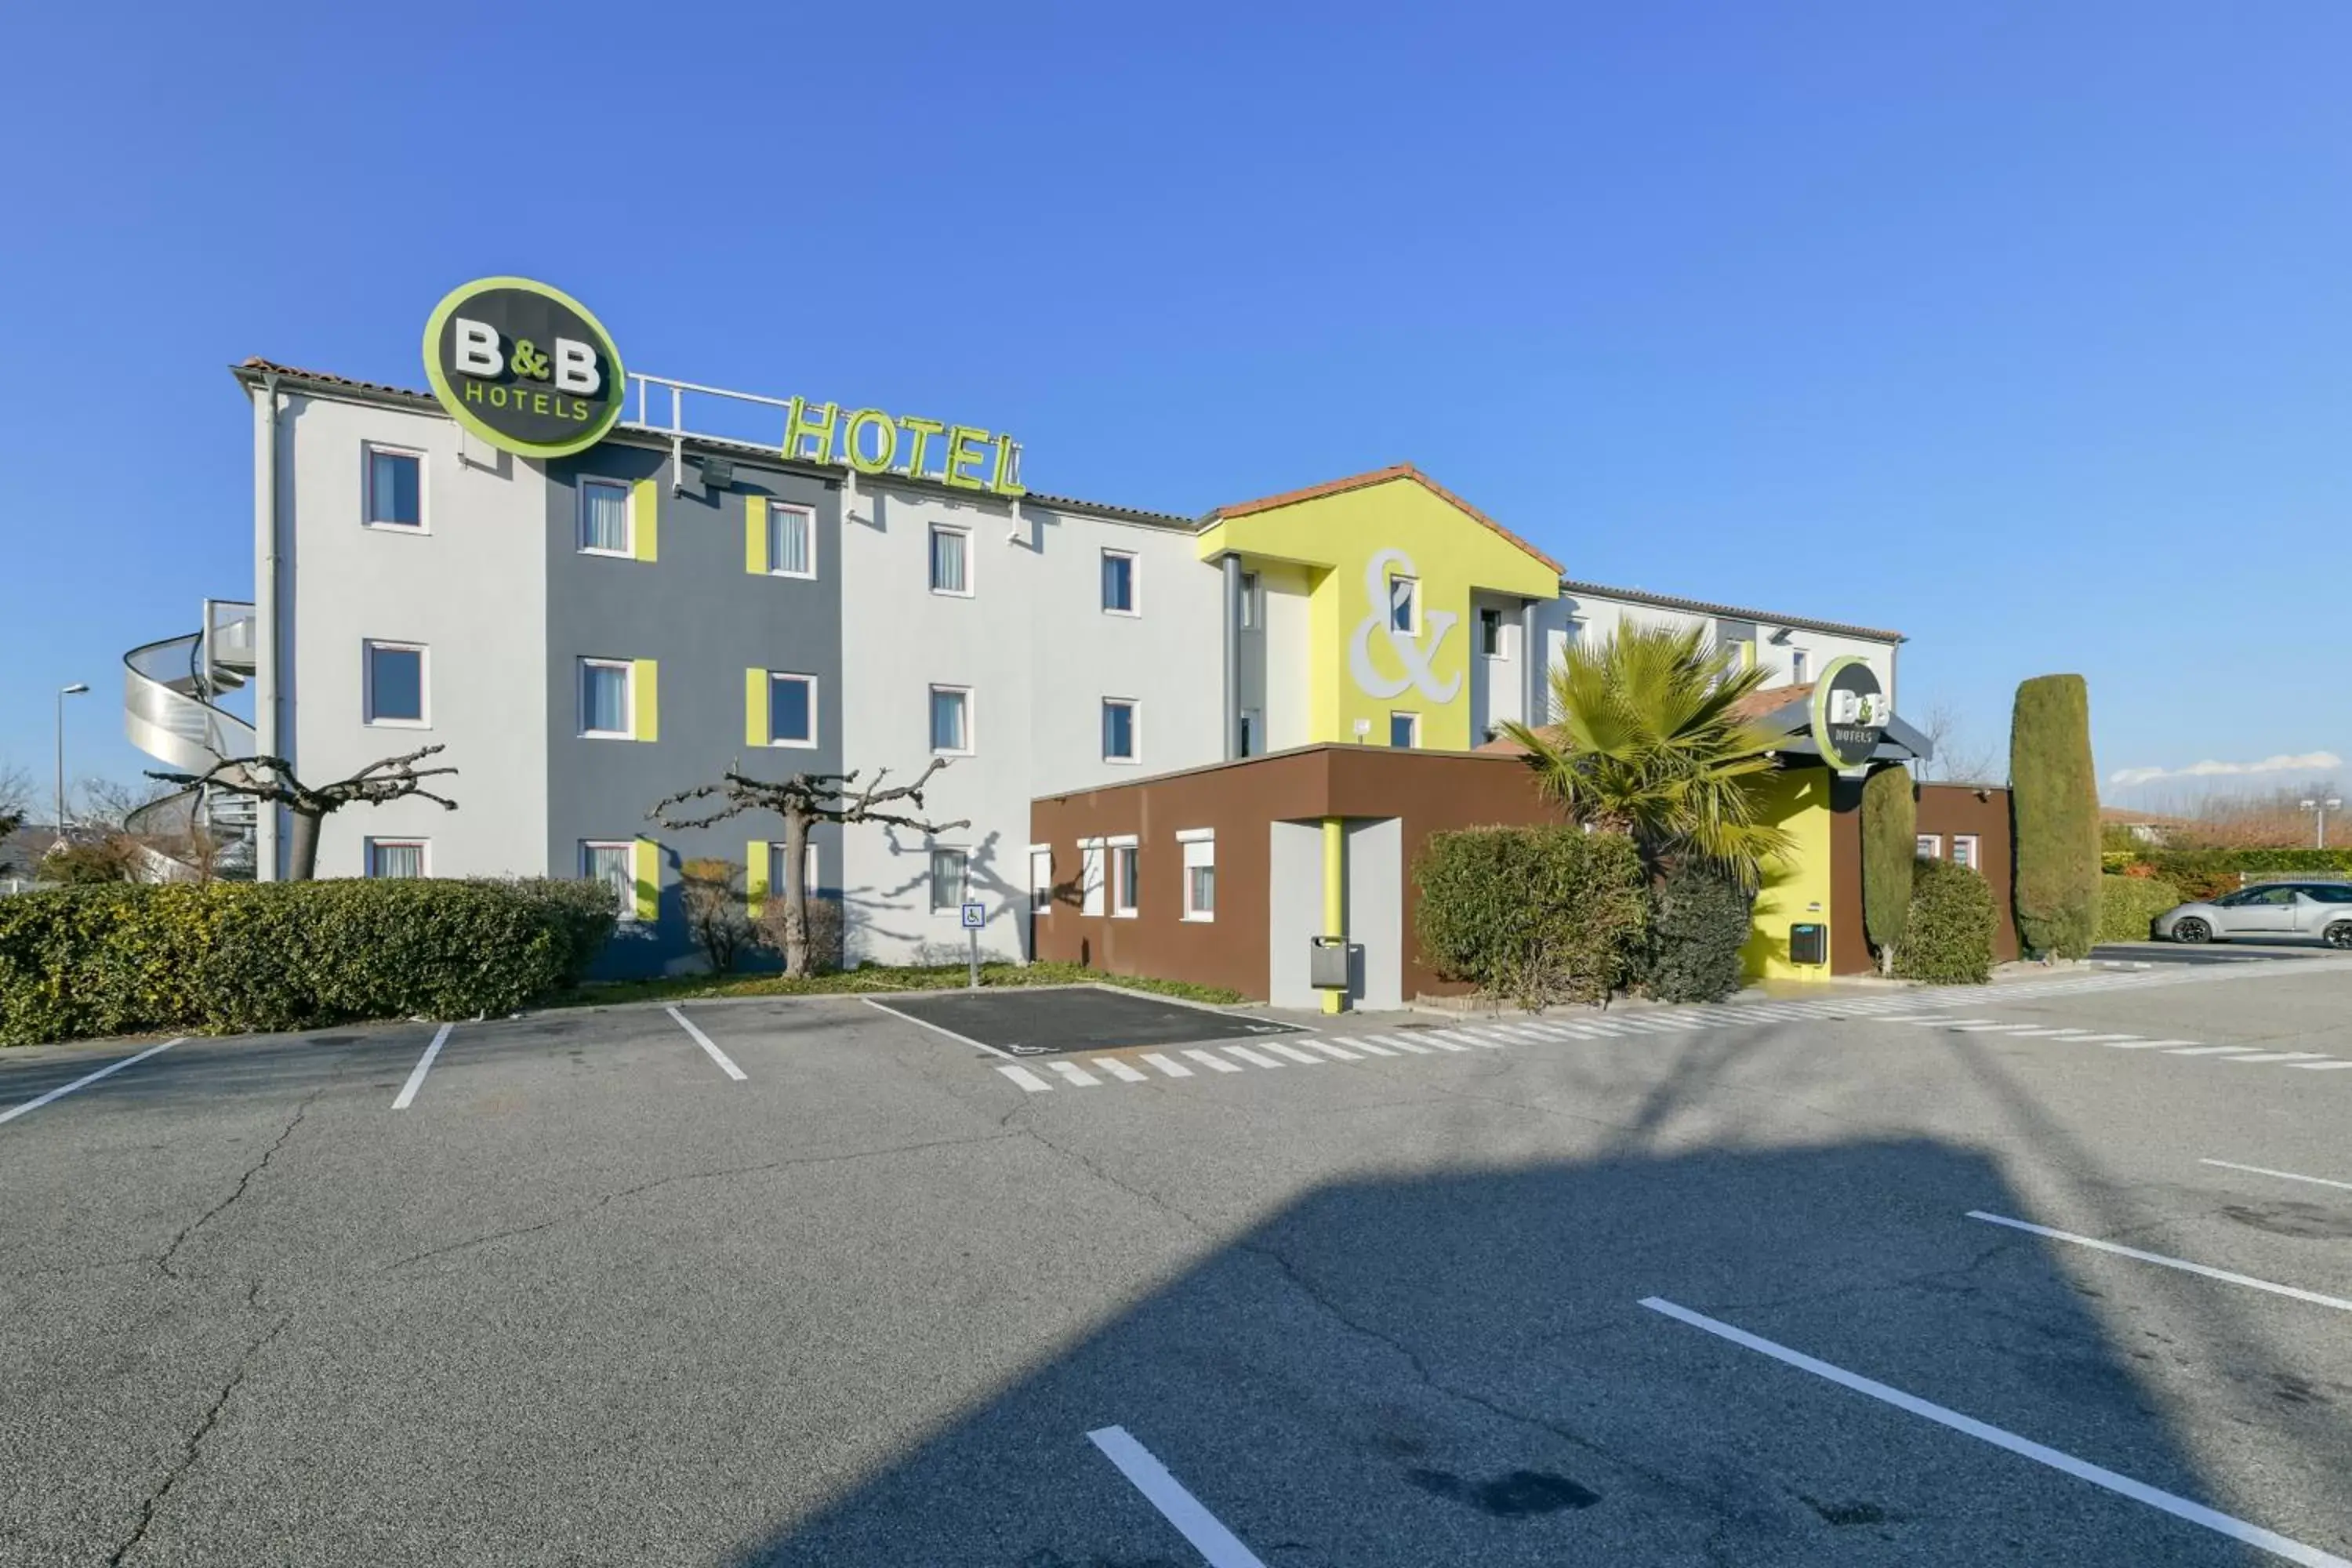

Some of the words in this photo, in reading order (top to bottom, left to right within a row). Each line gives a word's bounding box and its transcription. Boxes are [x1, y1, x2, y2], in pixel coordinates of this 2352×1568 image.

[456, 318, 601, 396] B&B
[466, 380, 589, 422] HOTELS
[781, 394, 1026, 496] HOTEL
[1348, 547, 1461, 704] &
[1831, 688, 1890, 728] B&B
[1835, 728, 1872, 744] HOTELS
